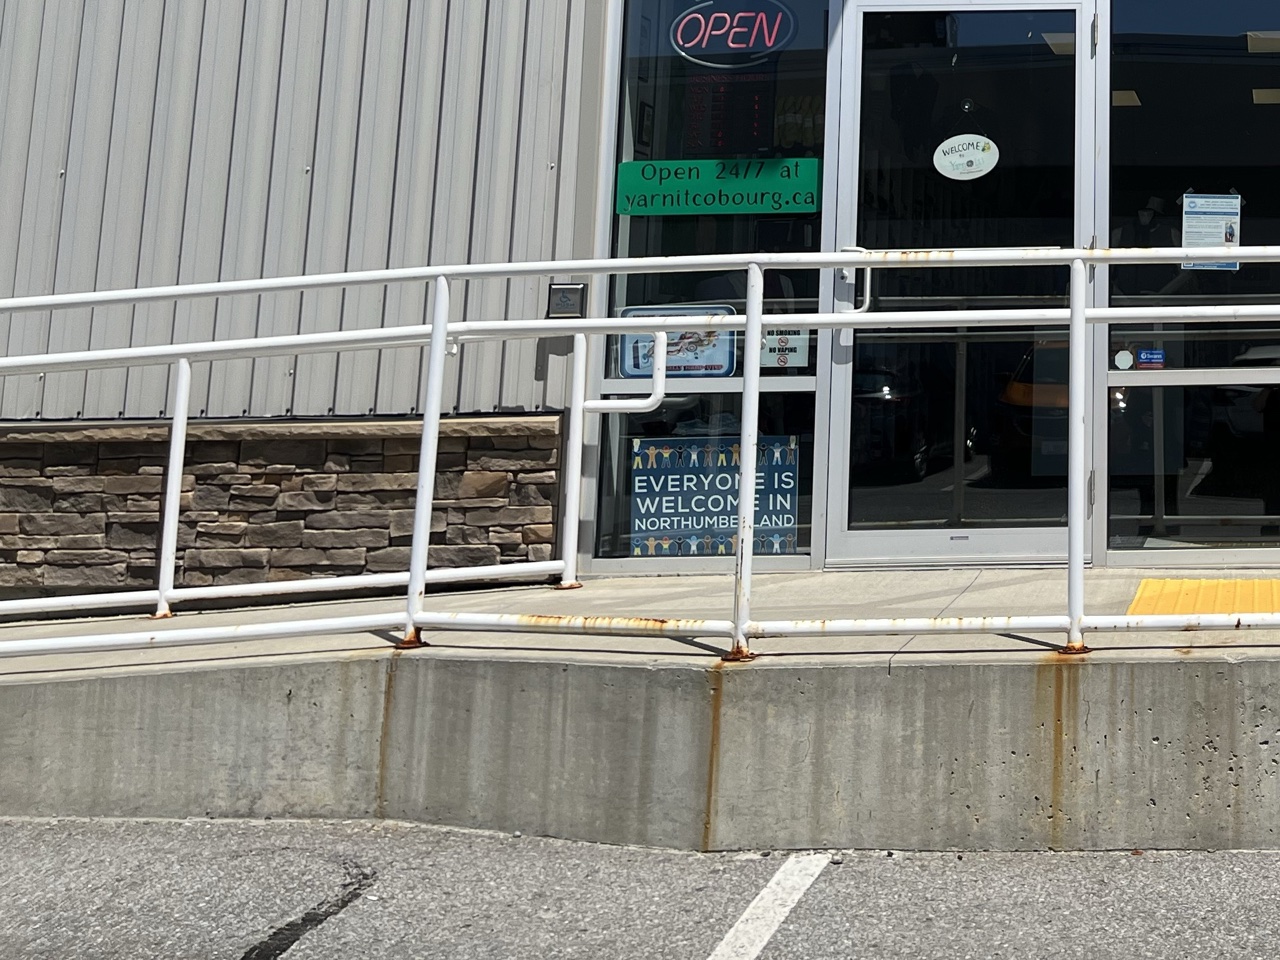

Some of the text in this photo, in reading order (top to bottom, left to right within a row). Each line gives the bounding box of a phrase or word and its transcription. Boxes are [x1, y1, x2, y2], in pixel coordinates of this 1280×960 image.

[677, 12, 782, 48] OPEN
[942, 141, 981, 156] WELCOME
[641, 160, 800, 185] Open 24/7 at
[624, 189, 815, 211] yarnitcobourg.ca
[774, 472, 794, 489] IS
[769, 493, 791, 510] IN
[635, 514, 794, 531] NORTHUMBEAND
